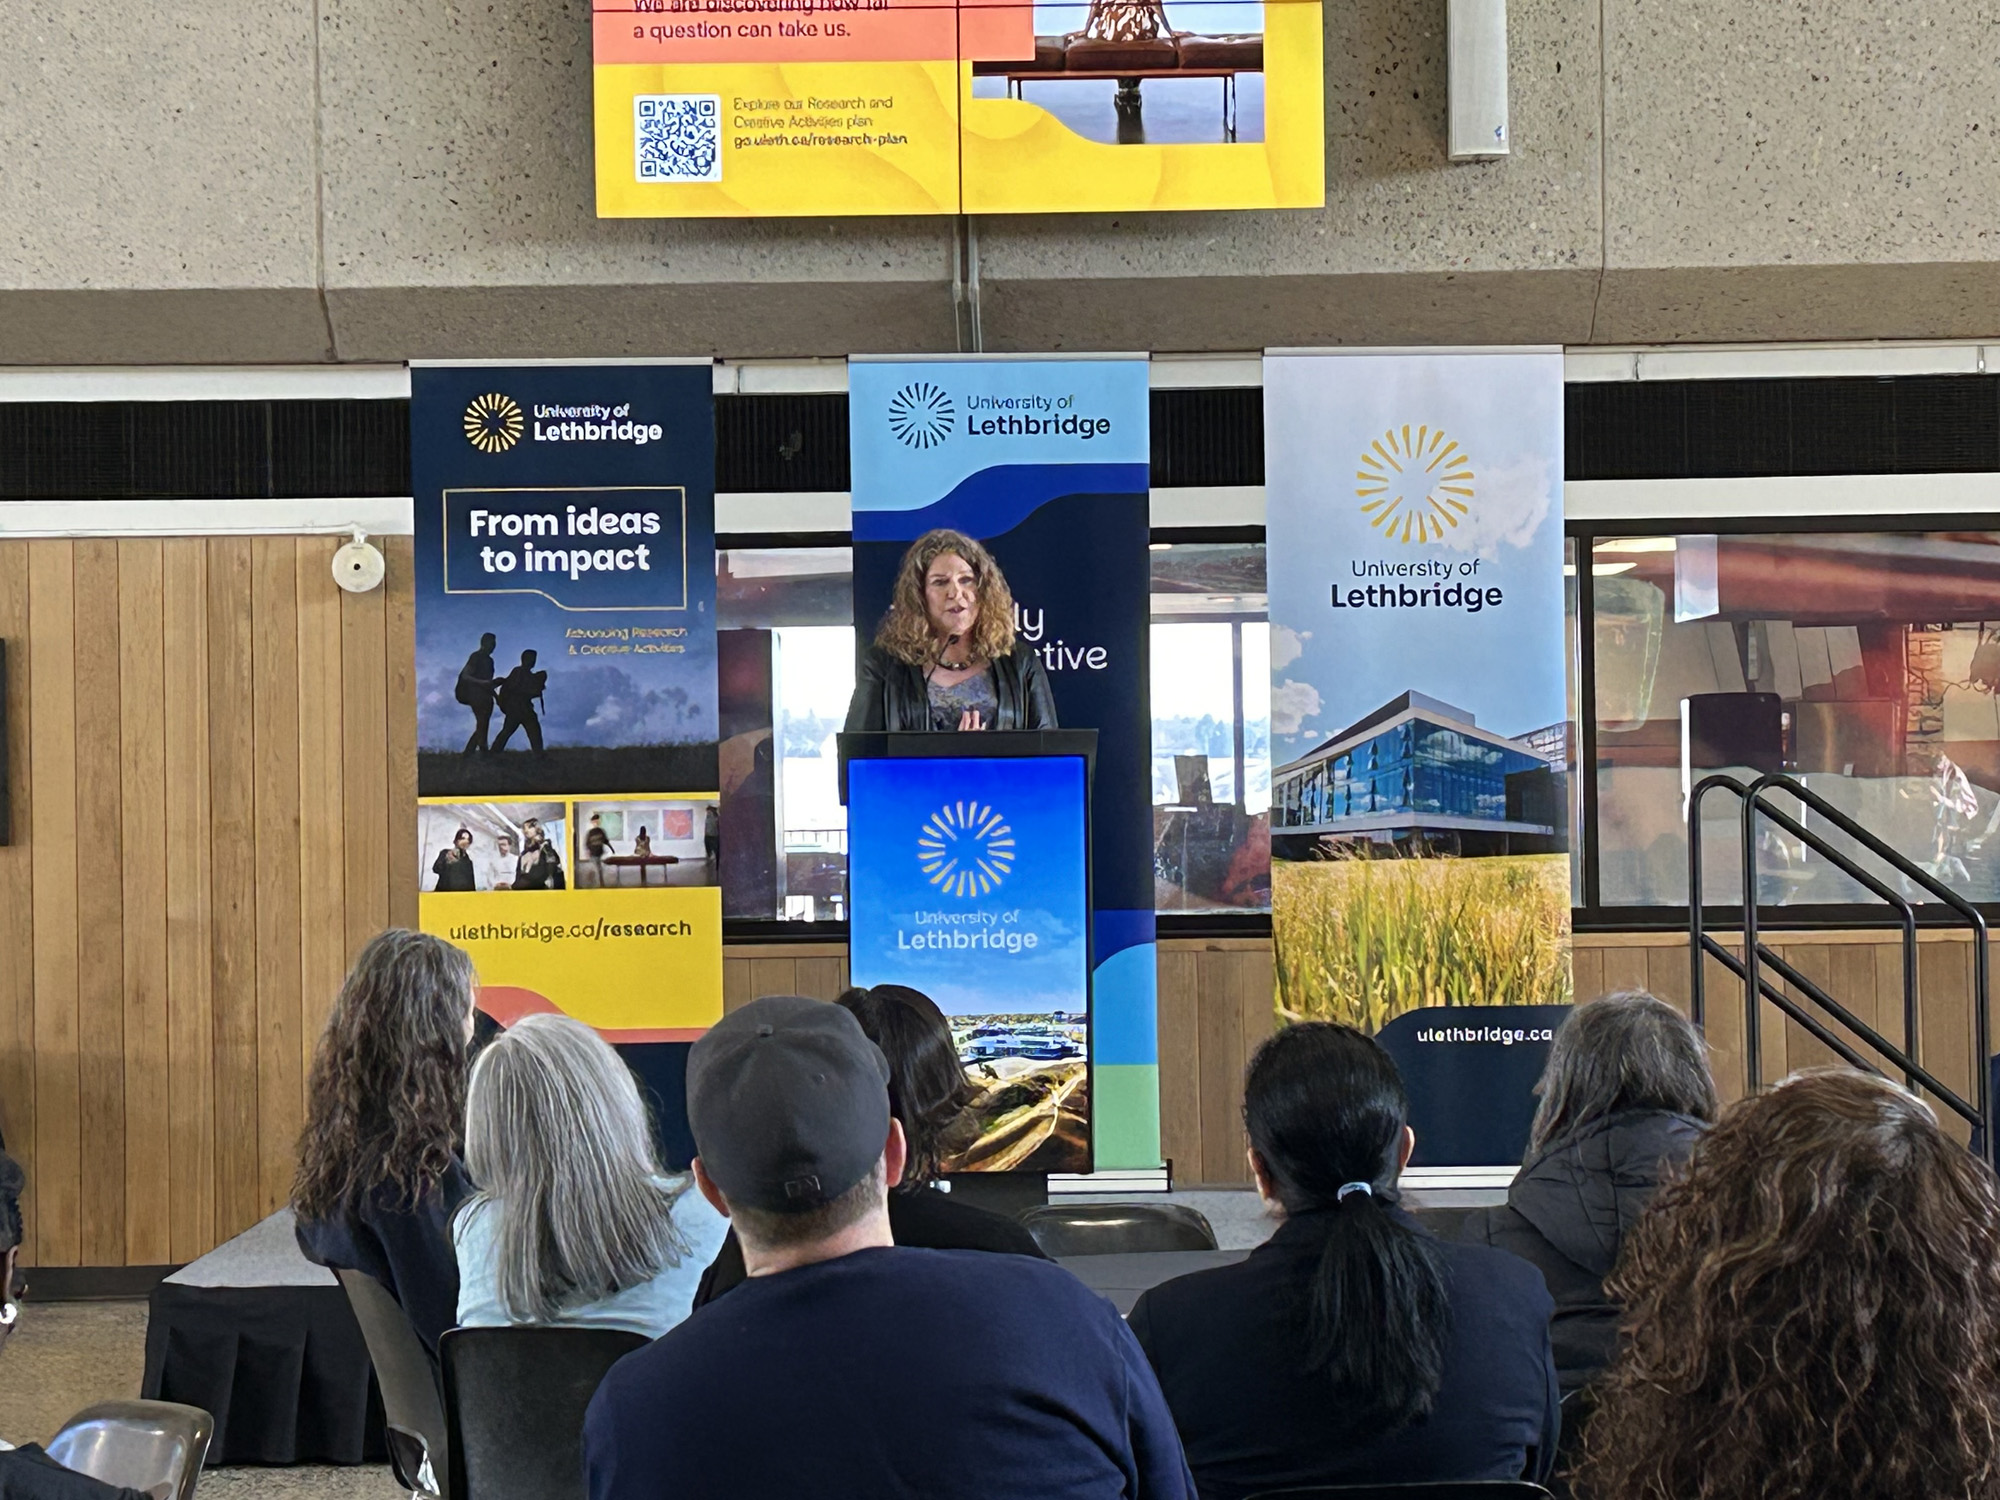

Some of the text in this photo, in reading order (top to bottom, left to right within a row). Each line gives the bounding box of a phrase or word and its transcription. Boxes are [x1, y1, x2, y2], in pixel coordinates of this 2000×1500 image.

[633, 20, 851, 44] a question can take us.
[808, 97, 866, 110] Research
[870, 96, 893, 109] and
[734, 115, 785, 128] Creative
[847, 114, 873, 129] plan
[533, 403, 630, 420] University of
[967, 394, 1075, 412] University of
[534, 420, 663, 445] Lethbridge
[968, 413, 1111, 440] Lethbridge
[470, 505, 661, 537] From ideas
[480, 541, 651, 581] to impact
[1352, 558, 1481, 580] University of
[1331, 582, 1503, 613] Lethbridge
[1014, 602, 1044, 641] ly
[1034, 640, 1108, 670] tive
[450, 917, 692, 943] ulethbridge.ca/research
[915, 909, 1021, 927] University of
[898, 928, 1038, 954] Lethbridge
[1417, 1027, 1552, 1045] ulethbridge.ca
